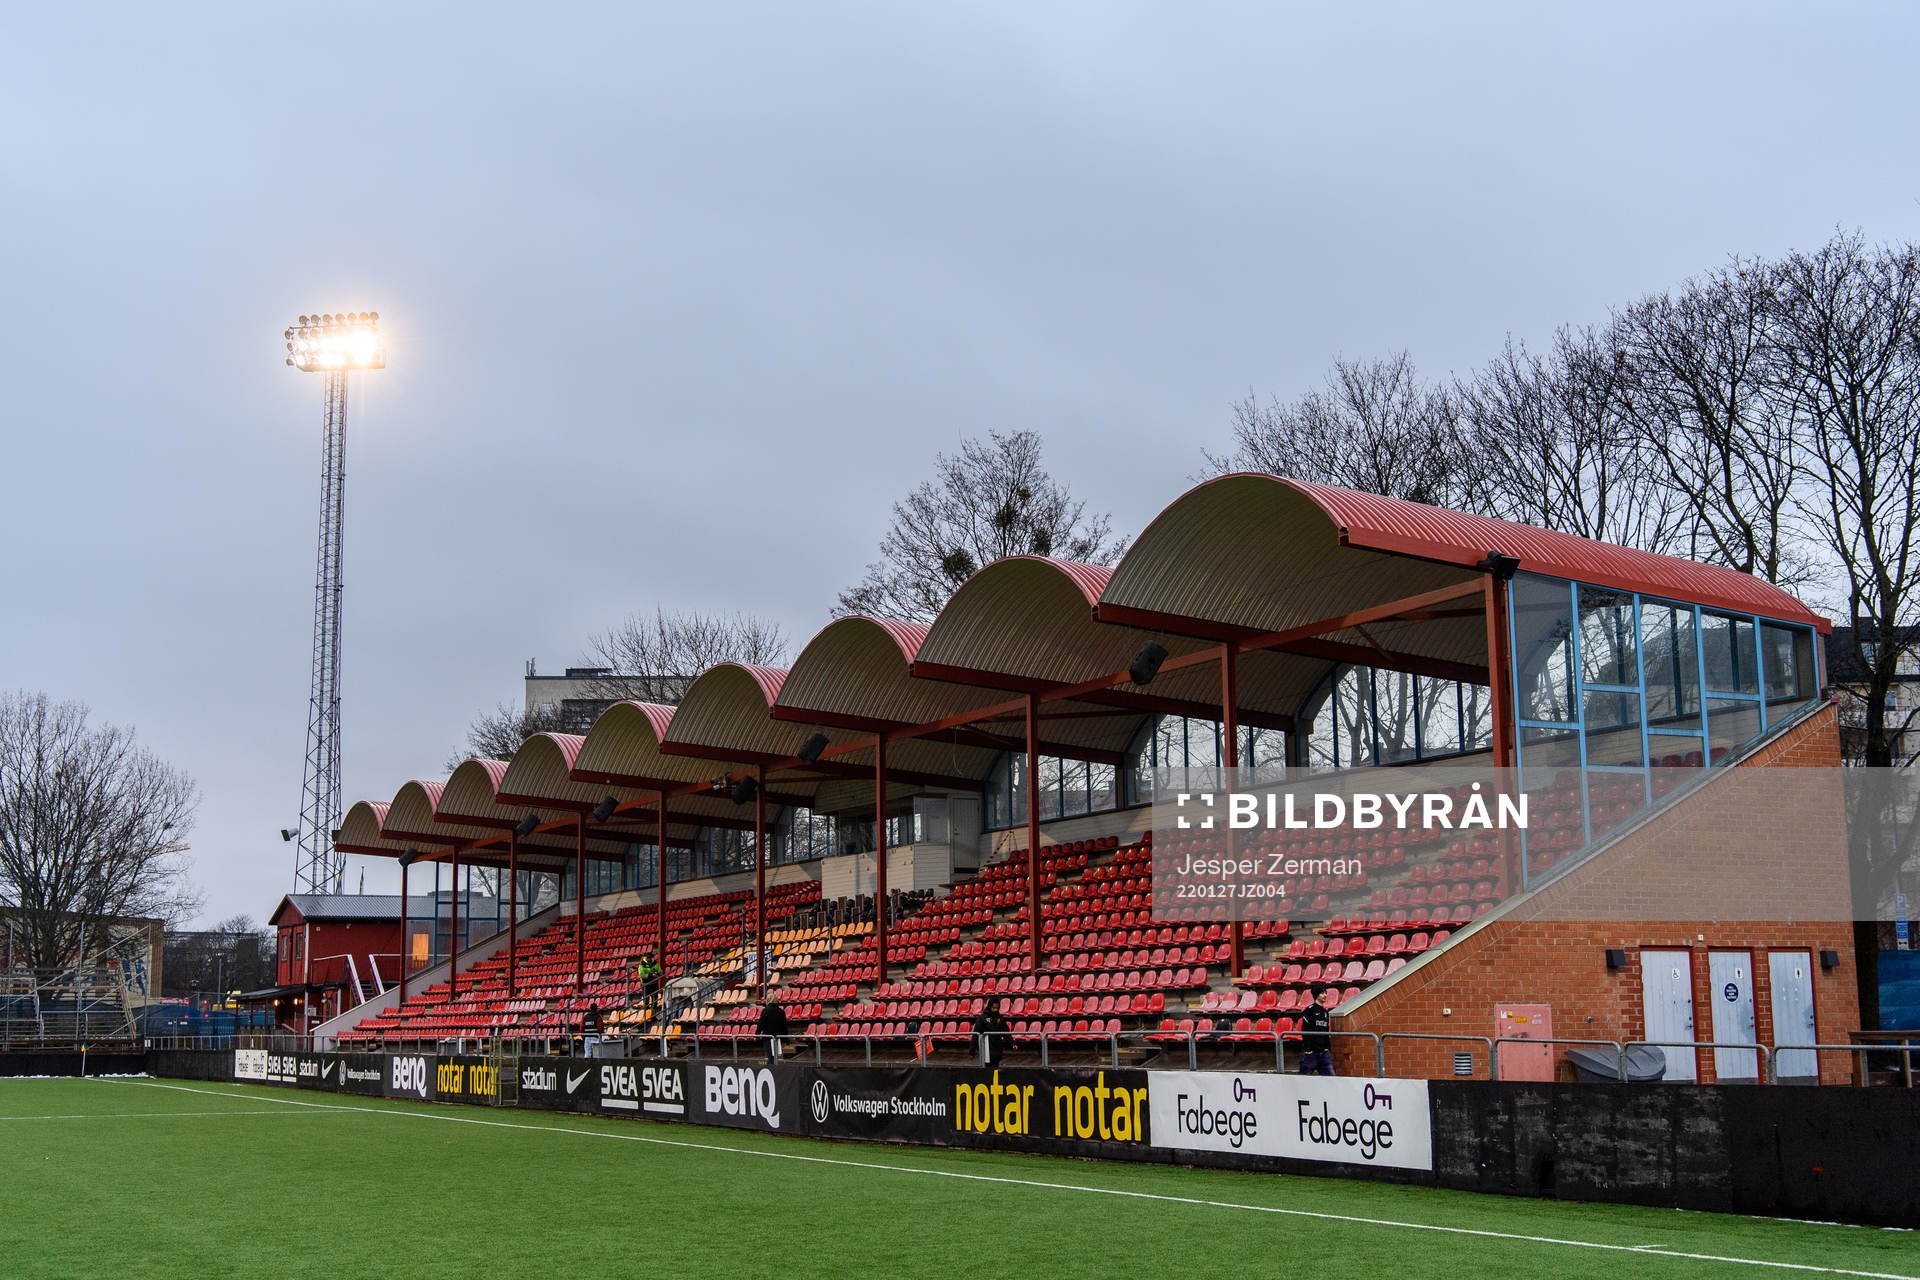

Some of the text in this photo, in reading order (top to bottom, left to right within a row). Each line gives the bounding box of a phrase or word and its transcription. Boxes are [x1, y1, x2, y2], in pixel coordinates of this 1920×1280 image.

[392, 1056, 427, 1098] BenQ
[437, 1057, 465, 1095] notar
[522, 1066, 557, 1091] stadium
[600, 1065, 684, 1101] SVEA SVEA
[705, 1065, 780, 1129] BenQ
[833, 1094, 946, 1118] Volkswagen Stockholm
[956, 1069, 1147, 1142] notar notar
[1178, 1094, 1394, 1160] Fabege Fabege
